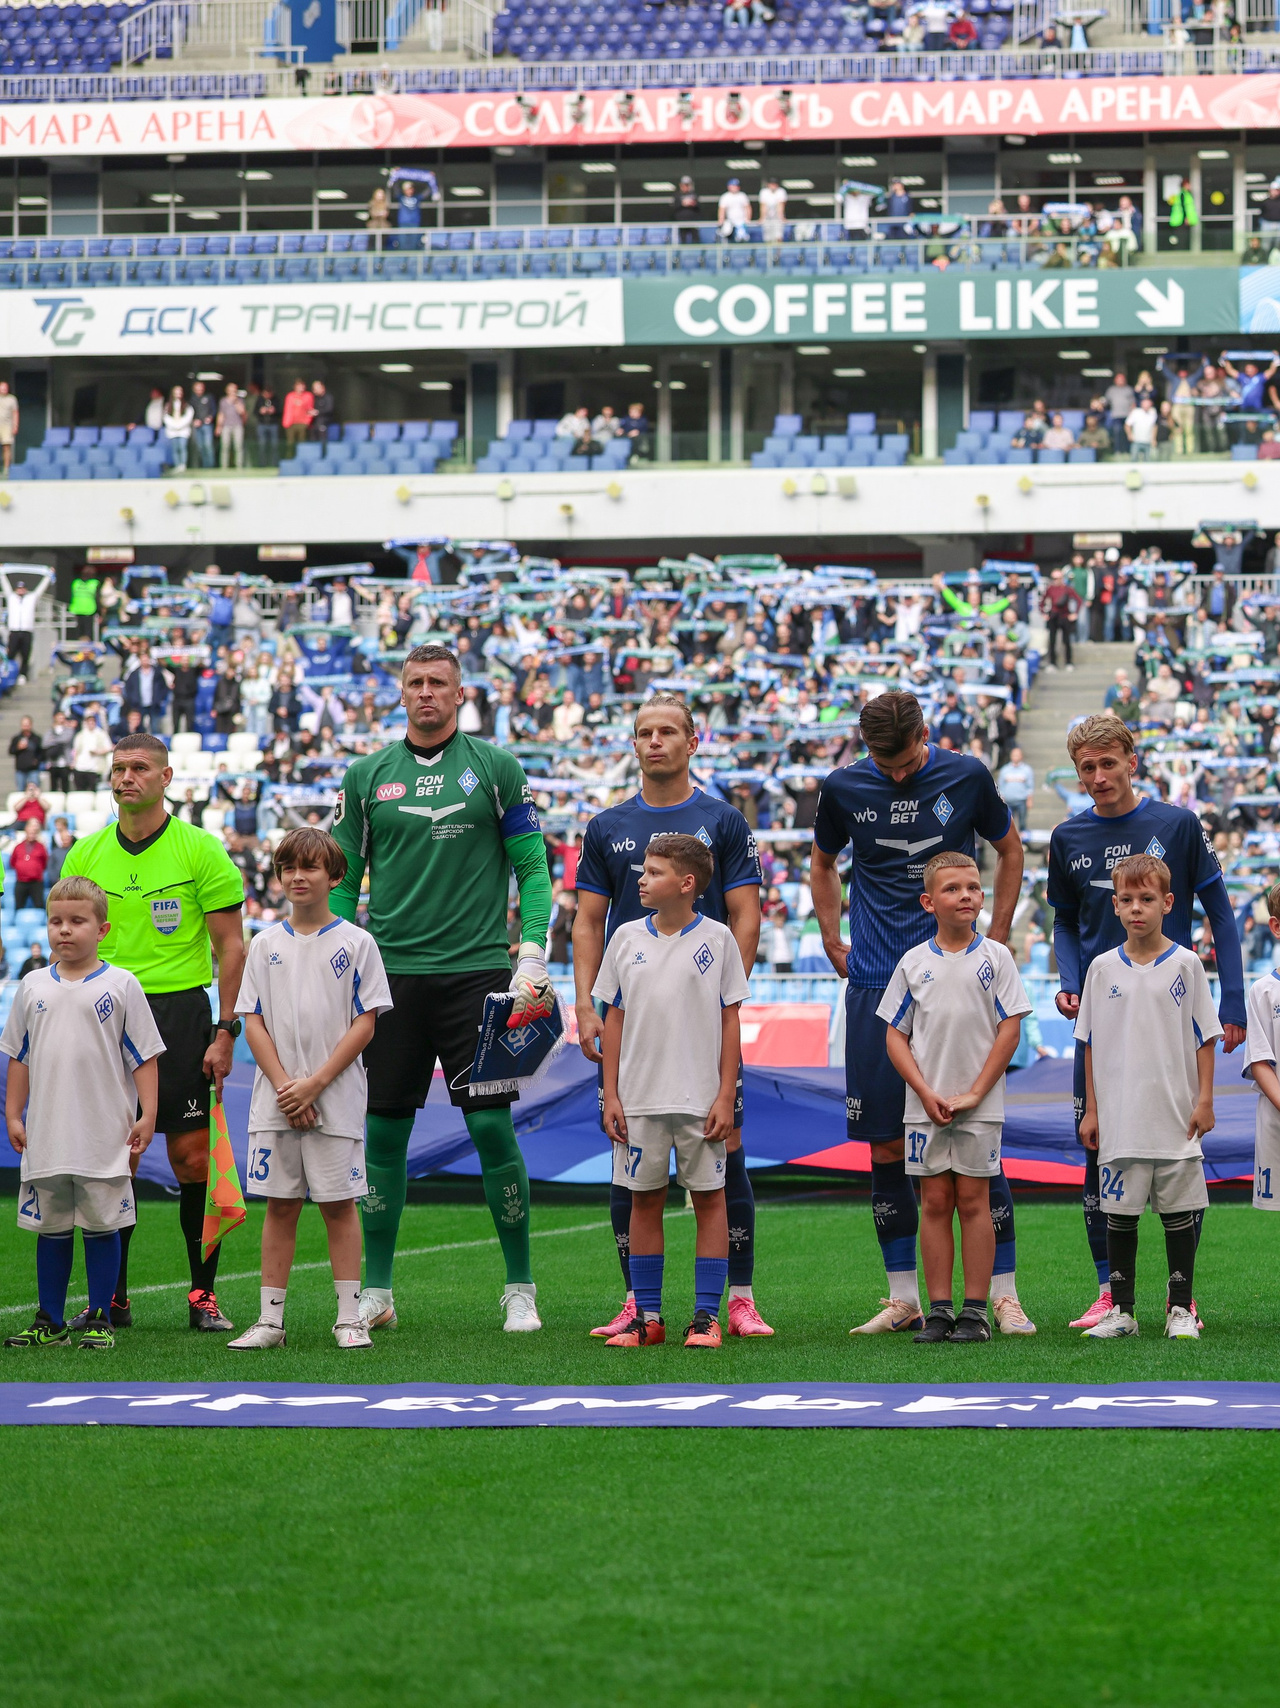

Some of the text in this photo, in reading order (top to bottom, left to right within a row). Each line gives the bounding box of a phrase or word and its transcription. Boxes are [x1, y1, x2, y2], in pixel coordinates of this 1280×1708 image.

[850, 88, 1043, 127] САМАРА
[1059, 84, 1204, 122] АРЕНА
[0, 109, 276, 146] МАРА АРЕНА
[119, 291, 588, 337] ДСК ТРАНССТРОЙ
[673, 278, 1100, 337] COFFEE LIKE
[415, 774, 445, 787] FON
[380, 784, 402, 797] wb
[415, 785, 444, 797] BET
[890, 800, 919, 812] FON
[853, 807, 878, 823] wb
[890, 812, 919, 825] BET
[612, 837, 636, 853] wb
[1104, 844, 1131, 858] FON
[1071, 855, 1092, 871] wb
[153, 901, 179, 912] FIFA
[908, 1131, 927, 1164] 17
[248, 1147, 272, 1181] 13
[503, 1183, 518, 1198] 30
[1101, 1166, 1125, 1201] 24
[20, 1184, 41, 1221] 21
